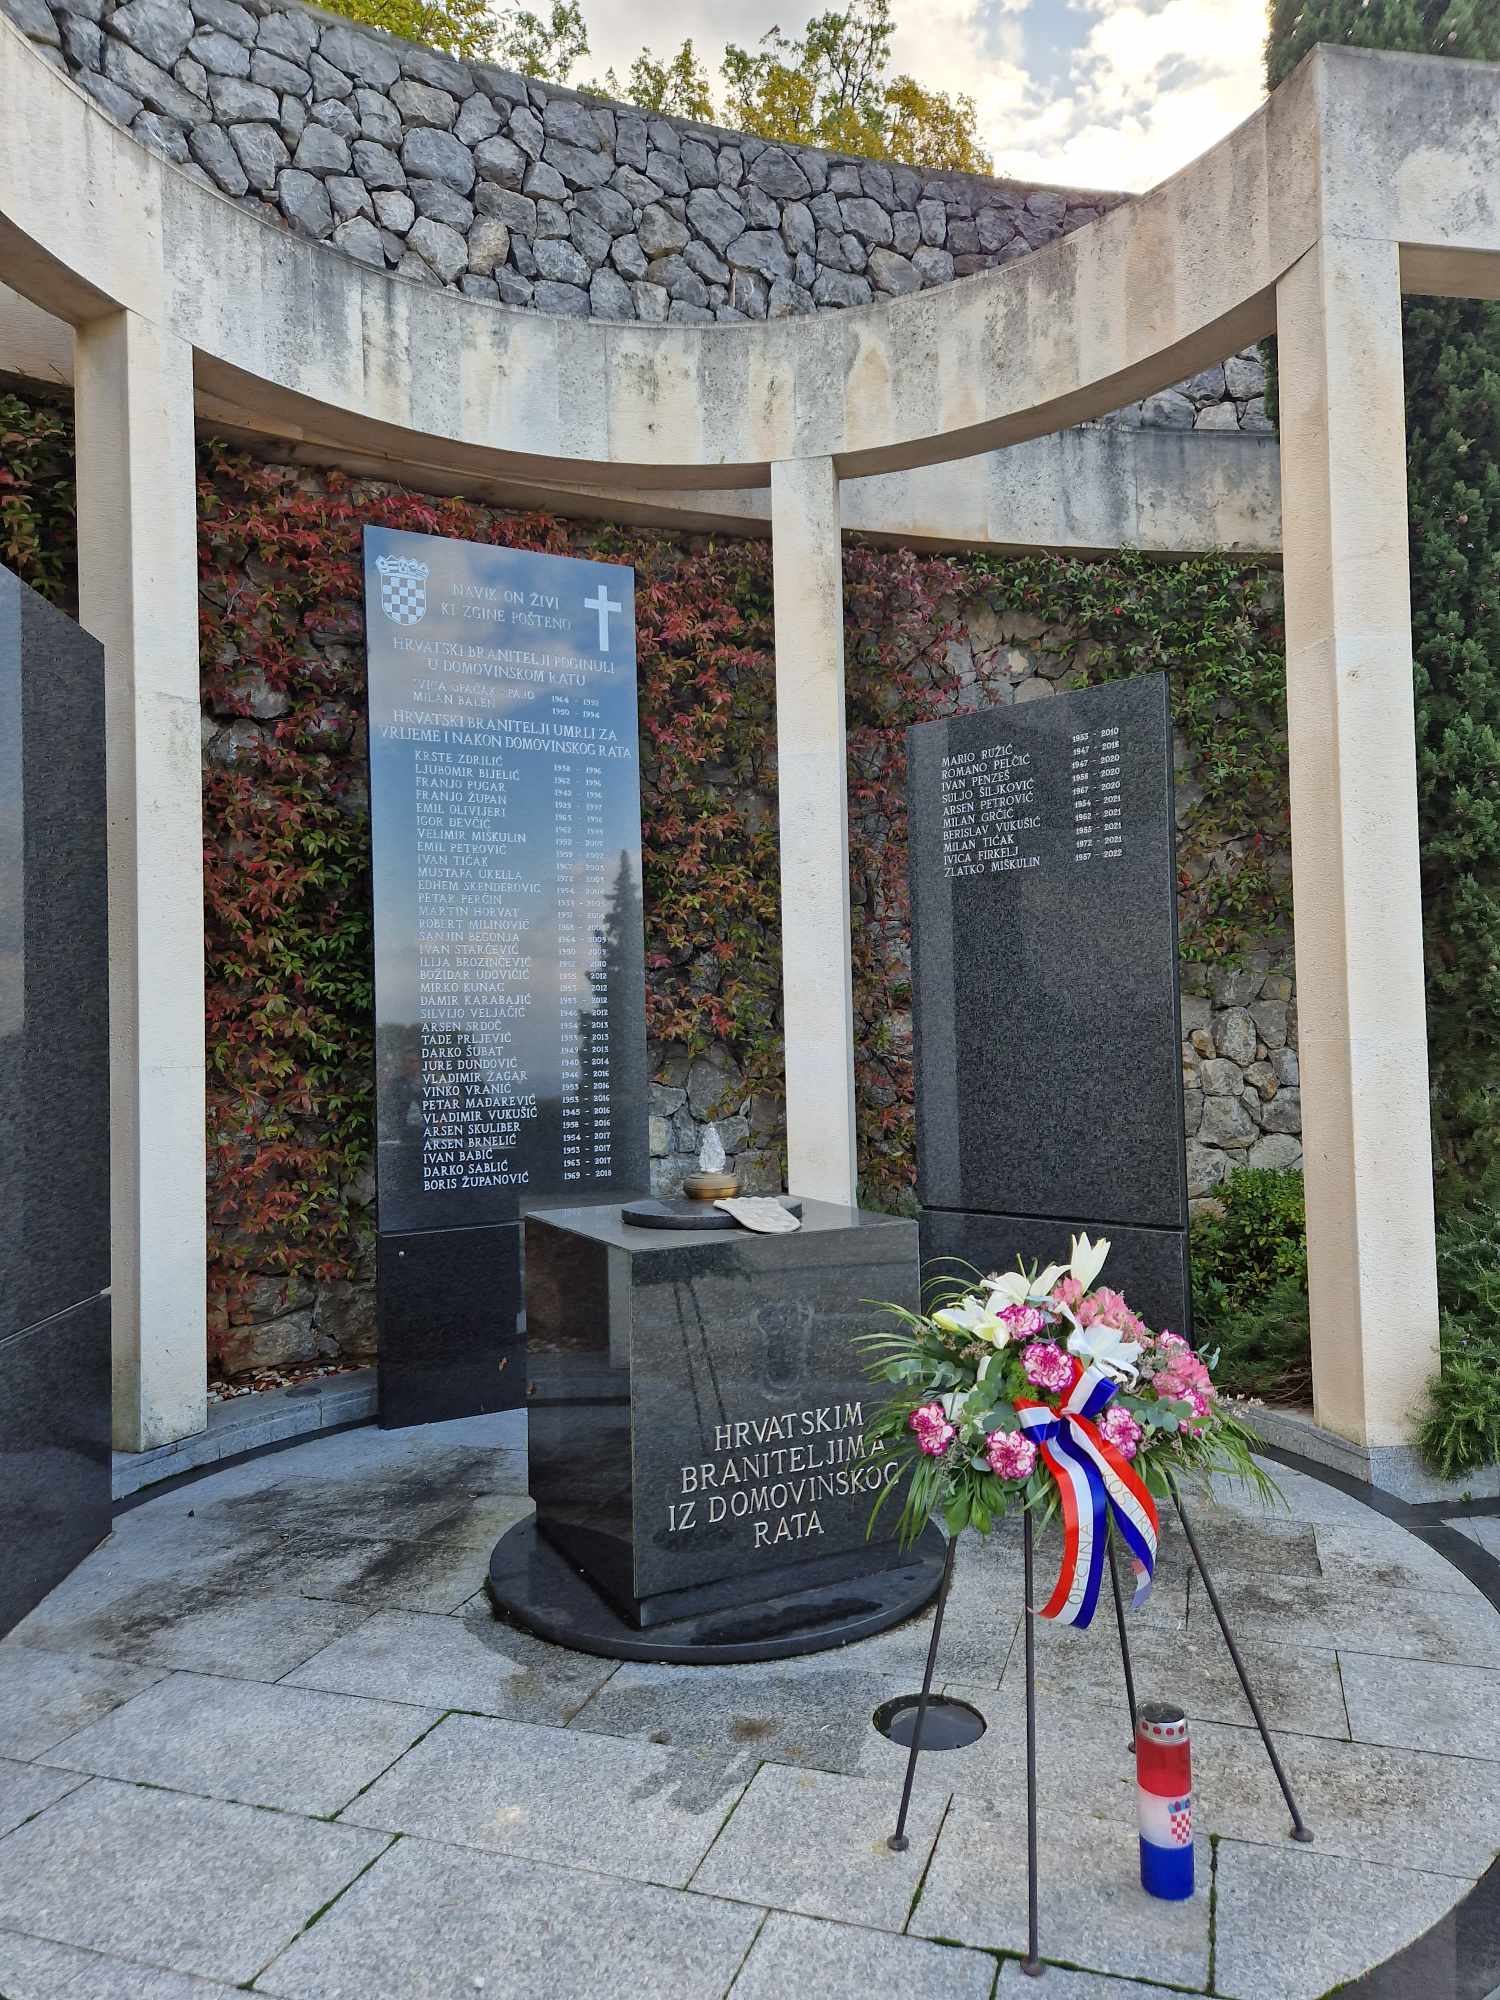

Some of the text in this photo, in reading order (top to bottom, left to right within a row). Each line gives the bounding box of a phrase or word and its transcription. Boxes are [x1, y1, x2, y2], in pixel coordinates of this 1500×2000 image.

[453, 584, 560, 609] NAVIK ON ŽIVI
[463, 605, 505, 621] ZGINE
[512, 611, 571, 631] POŠTENO
[393, 637, 615, 674] HRVATSKI BRANITELJI POGINULI
[428, 658, 585, 686] U DOMOVINSKOM RATU
[394, 710, 617, 741] HRVATSKI BRANITELJI UMRLI ZA
[380, 726, 440, 742] VRIJEME
[452, 732, 502, 747] NAKON
[505, 736, 595, 755] DOMOVINSKOG
[599, 745, 632, 758] RATA
[942, 752, 976, 768] MARIO
[981, 743, 1013, 760] RUŽIĆ
[1100, 727, 1119, 737] 2010
[415, 750, 453, 762] KRSTE
[415, 763, 520, 781] LJUBOMIR BIJELIĆ
[941, 763, 987, 780] ROMANO
[993, 752, 1030, 771] PELČIĆ
[941, 779, 971, 793] IVAN
[1100, 754, 1120, 764] 2020
[415, 776, 505, 792] FRANJO PUGAR
[942, 790, 973, 804] SULJO
[979, 778, 1034, 797] ŠILJKOVIĆ
[1100, 767, 1120, 778] 2020
[416, 790, 463, 801] FRANJO
[943, 803, 974, 817] ARSEN
[980, 791, 1034, 810] PETROVIĆ
[1101, 781, 1120, 791] 2020
[416, 802, 505, 817] EMIL OLIVIJERI
[943, 815, 975, 829] MILAN
[981, 808, 1014, 822] GRČIĆ
[1103, 794, 1121, 804] 2021
[416, 816, 444, 826] IGOR
[943, 825, 990, 841] BERISLAV
[996, 816, 1041, 833] VUKUŠIĆ
[1103, 808, 1121, 818] 2021
[416, 828, 465, 840] VELIMIR
[943, 839, 976, 853] MILAN
[1104, 821, 1122, 831] 2021
[417, 841, 507, 855] EMIL PETROVIĆ
[944, 853, 972, 865] IVICA
[978, 846, 1019, 862] FIRKELJ
[1104, 835, 1122, 845] 2021
[418, 854, 447, 865] IVAN
[944, 863, 985, 878] ZLATKO
[991, 856, 1040, 872] MIŠKULIN
[1103, 848, 1123, 858] 2022
[418, 867, 472, 878] MUSTAFA
[418, 880, 459, 891] EDHEM
[419, 906, 520, 918] MARTIN HORVAT
[419, 919, 464, 929] ROBERT
[420, 943, 520, 955] IVAN STARČEVIĆ
[420, 968, 470, 980] BOŽIDAR
[420, 983, 458, 992] MIRKO
[592, 984, 608, 992] 2012
[420, 993, 531, 1006] DAMIR KARABAJIĆ
[420, 1009, 465, 1018] SILVIJO
[421, 1022, 461, 1032] ARSEN
[421, 1032, 512, 1045] TADE PRLJEVIĆ
[422, 1045, 504, 1059] DARKO ŠUBAT
[421, 1058, 518, 1071] JURE DUNDOVIĆ
[423, 1072, 482, 1084] VLADIMIR
[423, 1083, 512, 1097] VINKO VRANIĆ
[422, 1100, 460, 1111] PETAR
[423, 1111, 482, 1125] VLADIMIR
[488, 1107, 538, 1120] VUKUŠIĆ
[424, 1125, 463, 1138] ARSEN
[468, 1122, 521, 1135] SKULIBER
[424, 1138, 463, 1151] ARSEN
[468, 1134, 517, 1147] BRNELIĆ
[594, 1132, 611, 1140] 2017
[424, 1153, 454, 1164] IVAN
[459, 1149, 493, 1162] BABIĆ
[424, 1157, 611, 1178] DARKO SABLIĆ 2017
[424, 1178, 457, 1191] BORIS
[461, 1172, 529, 1188] ŽUPANOVIĆ
[595, 1169, 612, 1177] 2018
[714, 1402, 864, 1451] HRVATSKIM
[681, 1434, 887, 1494] BRANITELJIMA
[668, 1462, 899, 1532] IZ DOMOVINSKOG
[754, 1510, 825, 1548] RATA
